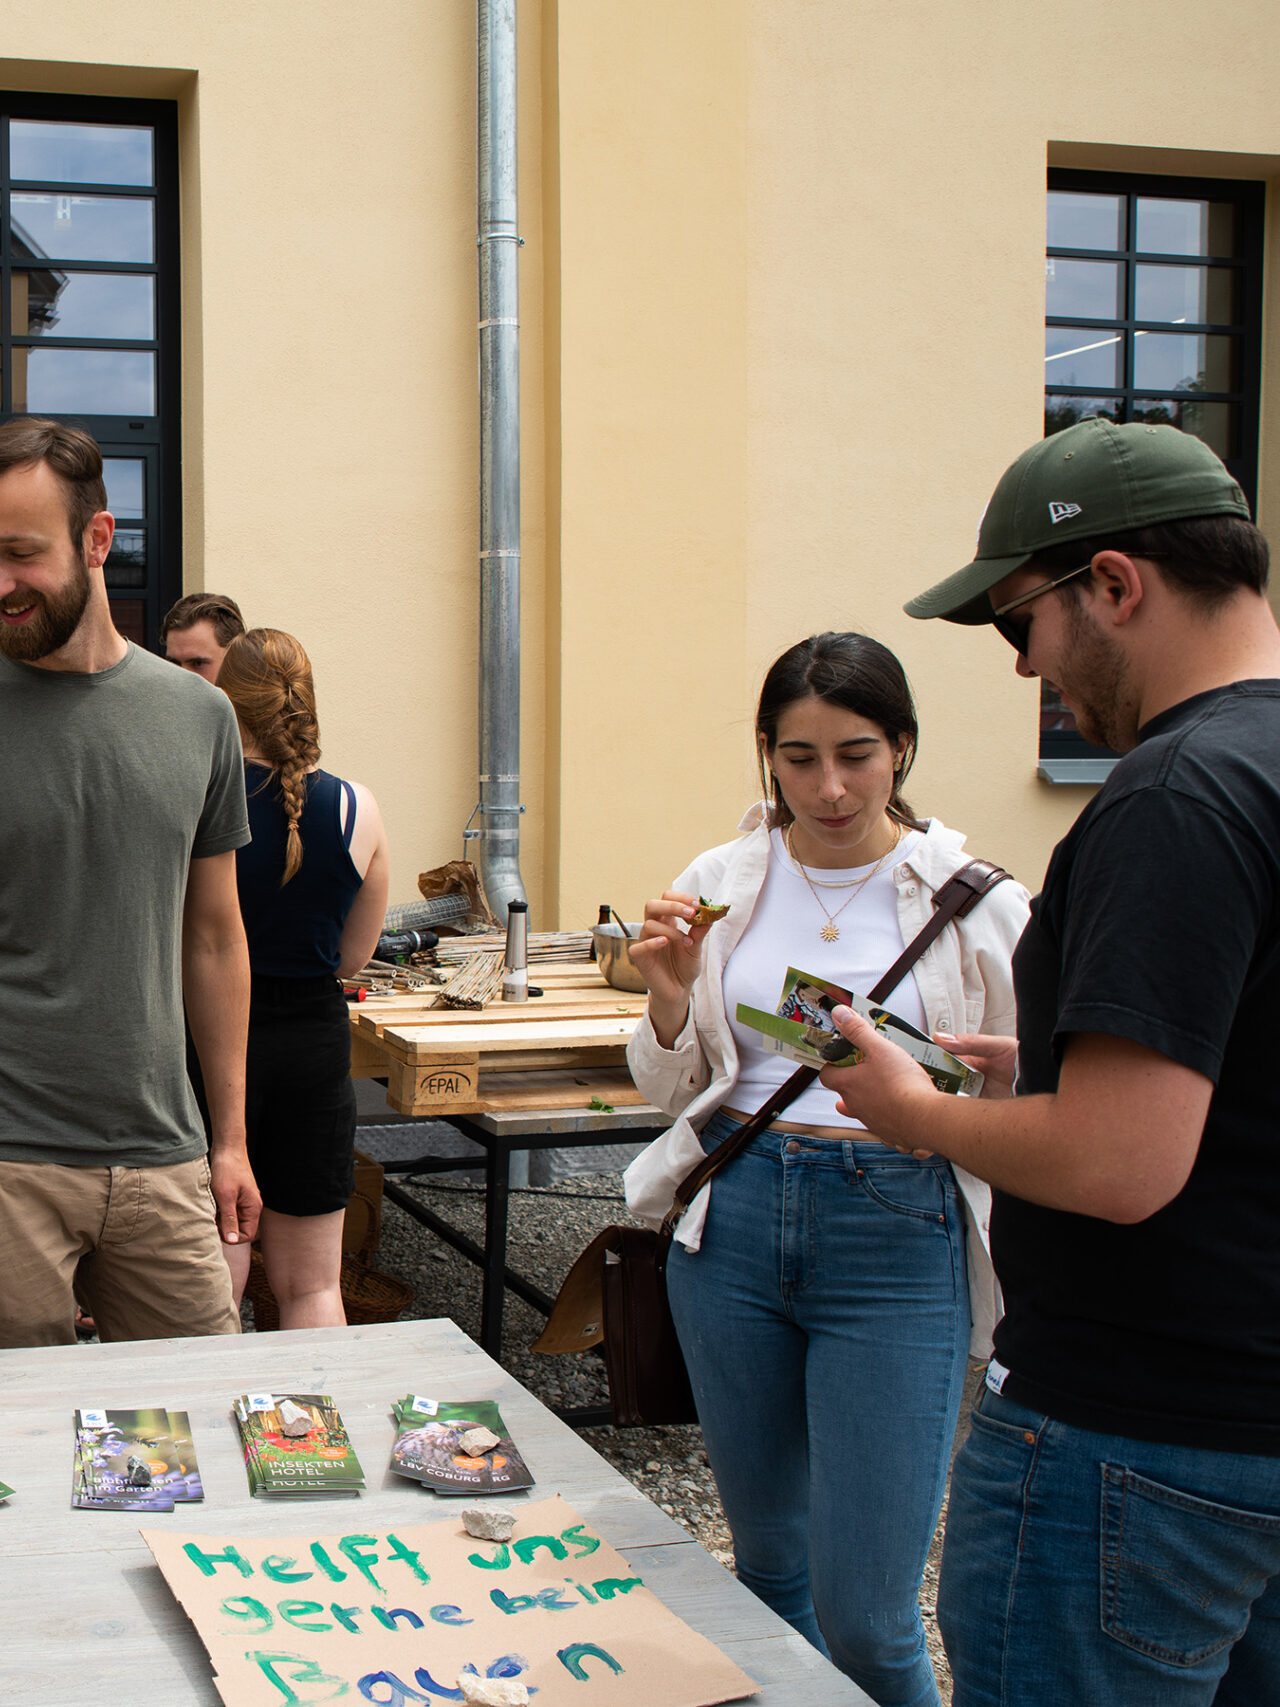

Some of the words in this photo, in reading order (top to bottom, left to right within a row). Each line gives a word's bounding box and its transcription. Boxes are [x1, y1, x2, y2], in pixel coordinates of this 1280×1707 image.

[428, 1078, 460, 1095] EPAL
[268, 1461, 345, 1469] INSEKTEN
[271, 1468, 324, 1476] HOTEL
[400, 1460, 424, 1471] LBV
[426, 1468, 481, 1483] COBURG
[115, 1485, 163, 1493] Garten
[182, 1533, 432, 1598] Helft
[218, 1595, 476, 1636] gerne
[489, 1576, 645, 1615] beim
